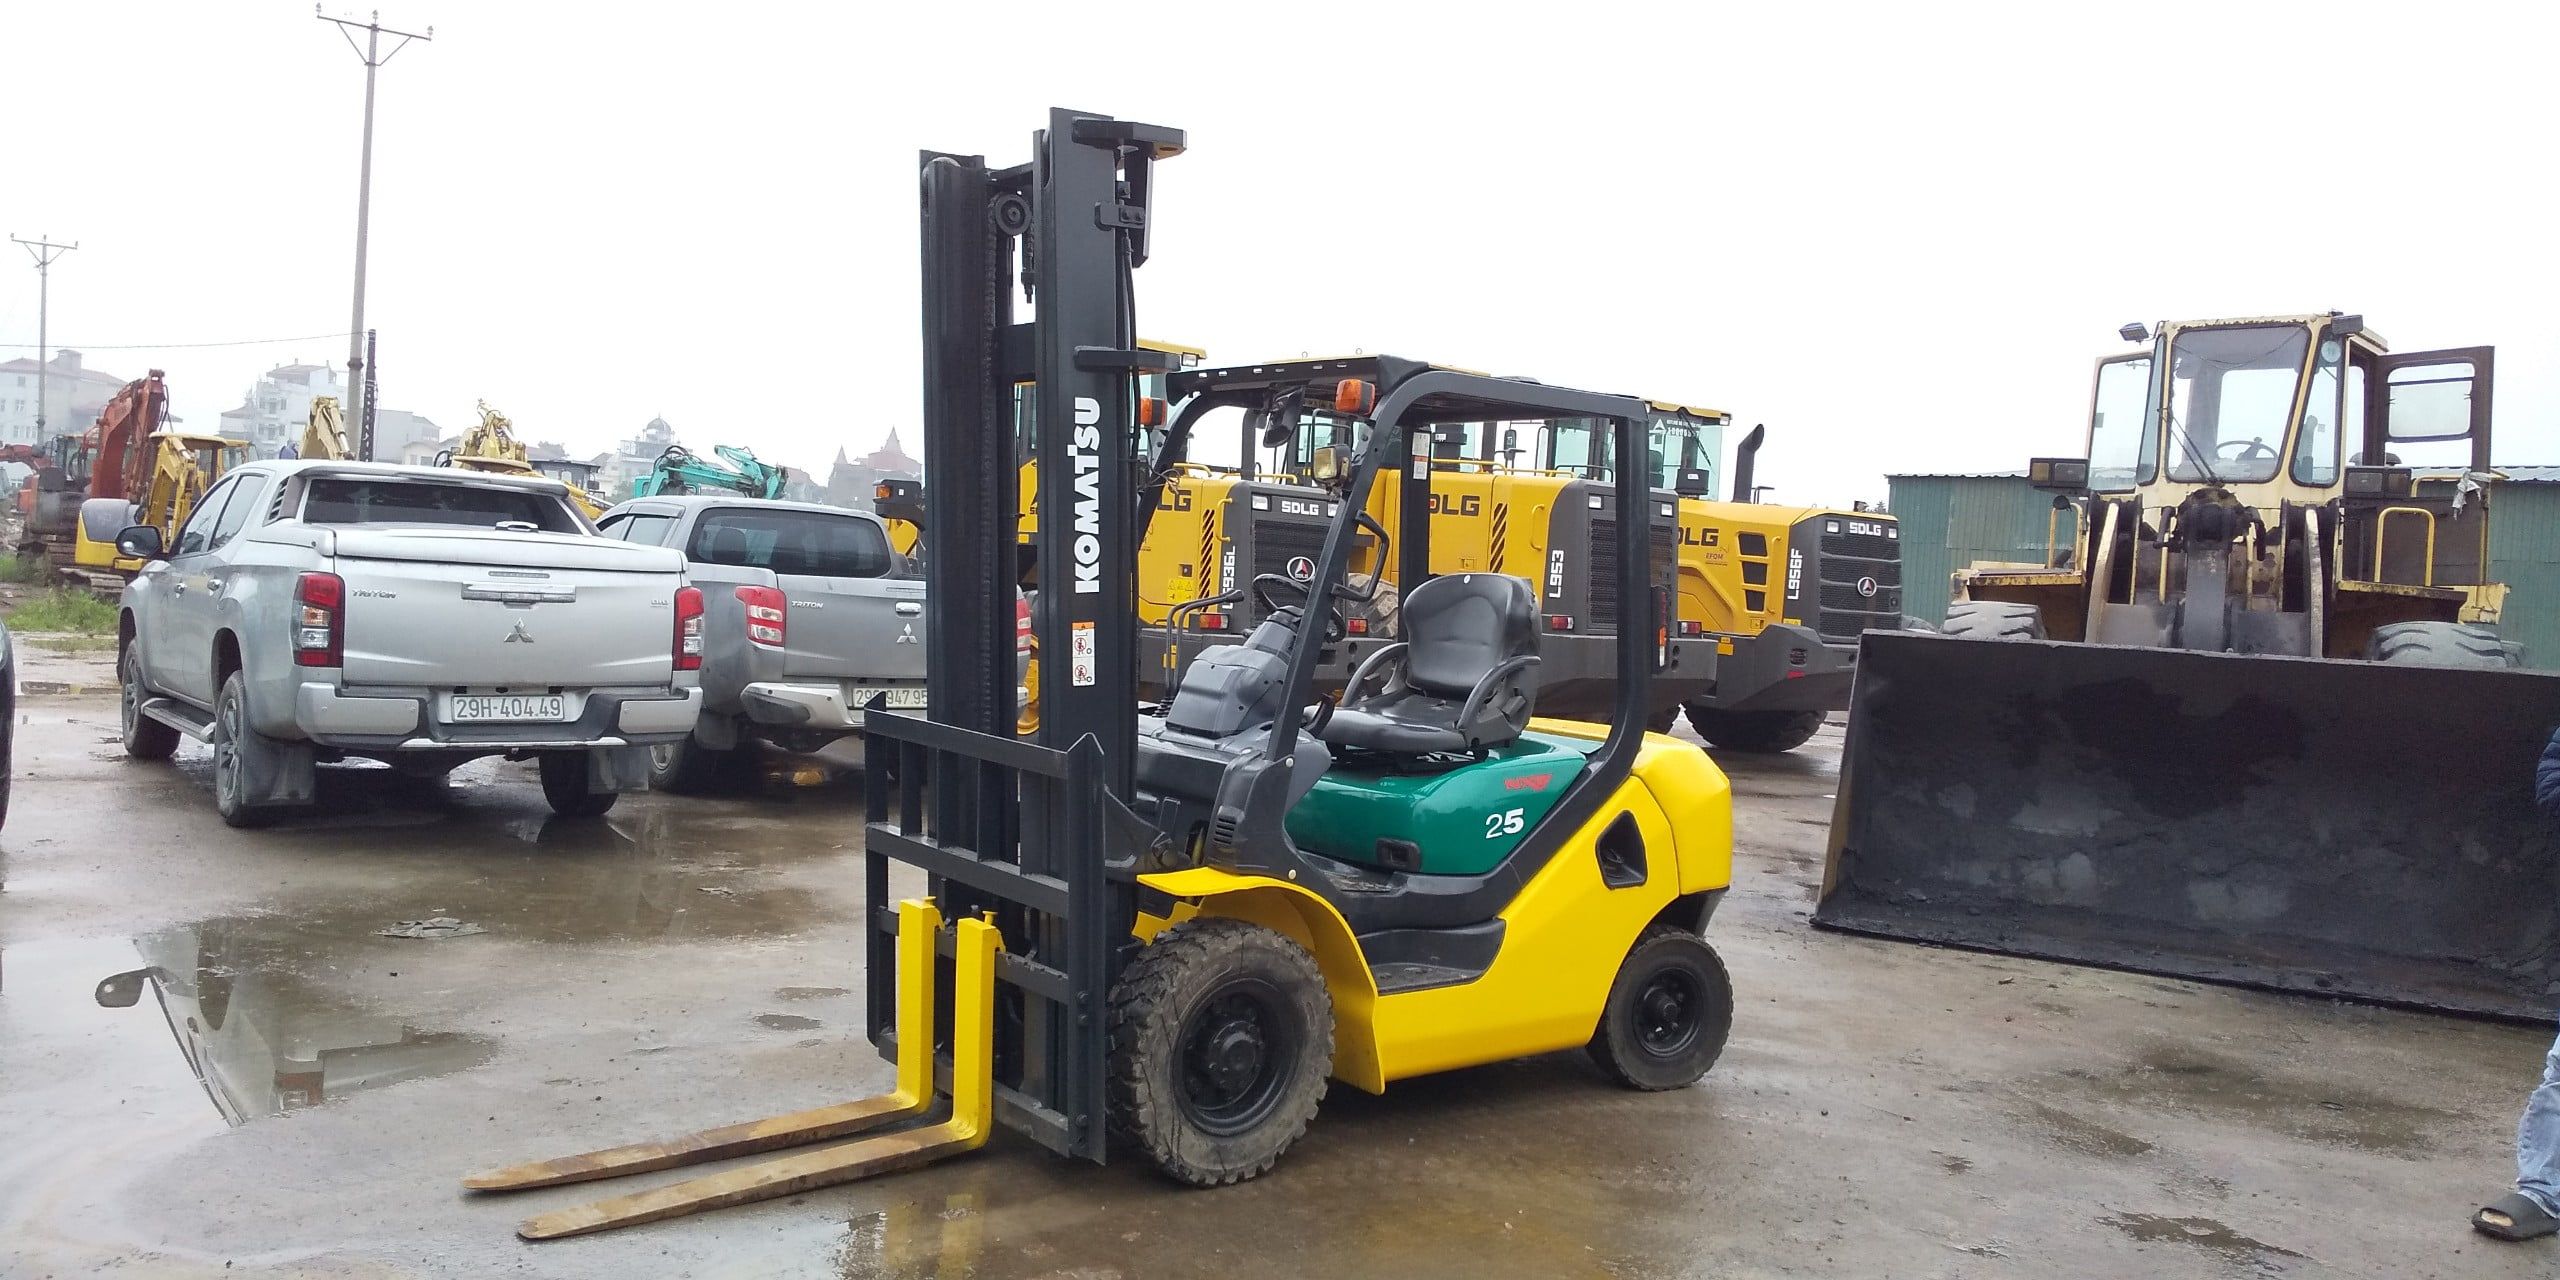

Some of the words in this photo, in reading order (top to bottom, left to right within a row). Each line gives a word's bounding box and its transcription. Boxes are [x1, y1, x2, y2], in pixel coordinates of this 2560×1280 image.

[1067, 397, 1101, 593] KOMATSU
[1157, 489, 1192, 512] LG
[1430, 494, 1480, 516] DLG
[1281, 500, 1319, 516] SDLG
[1848, 521, 1882, 536] SDLG
[1548, 549, 1564, 598] L953
[1787, 548, 1803, 600] L956F
[352, 589, 397, 599] TRITON
[791, 600, 824, 609] TRITON
[856, 689, 928, 705] 29947.95
[456, 698, 561, 718] 29H-404.49
[1485, 807, 1524, 839] 25
